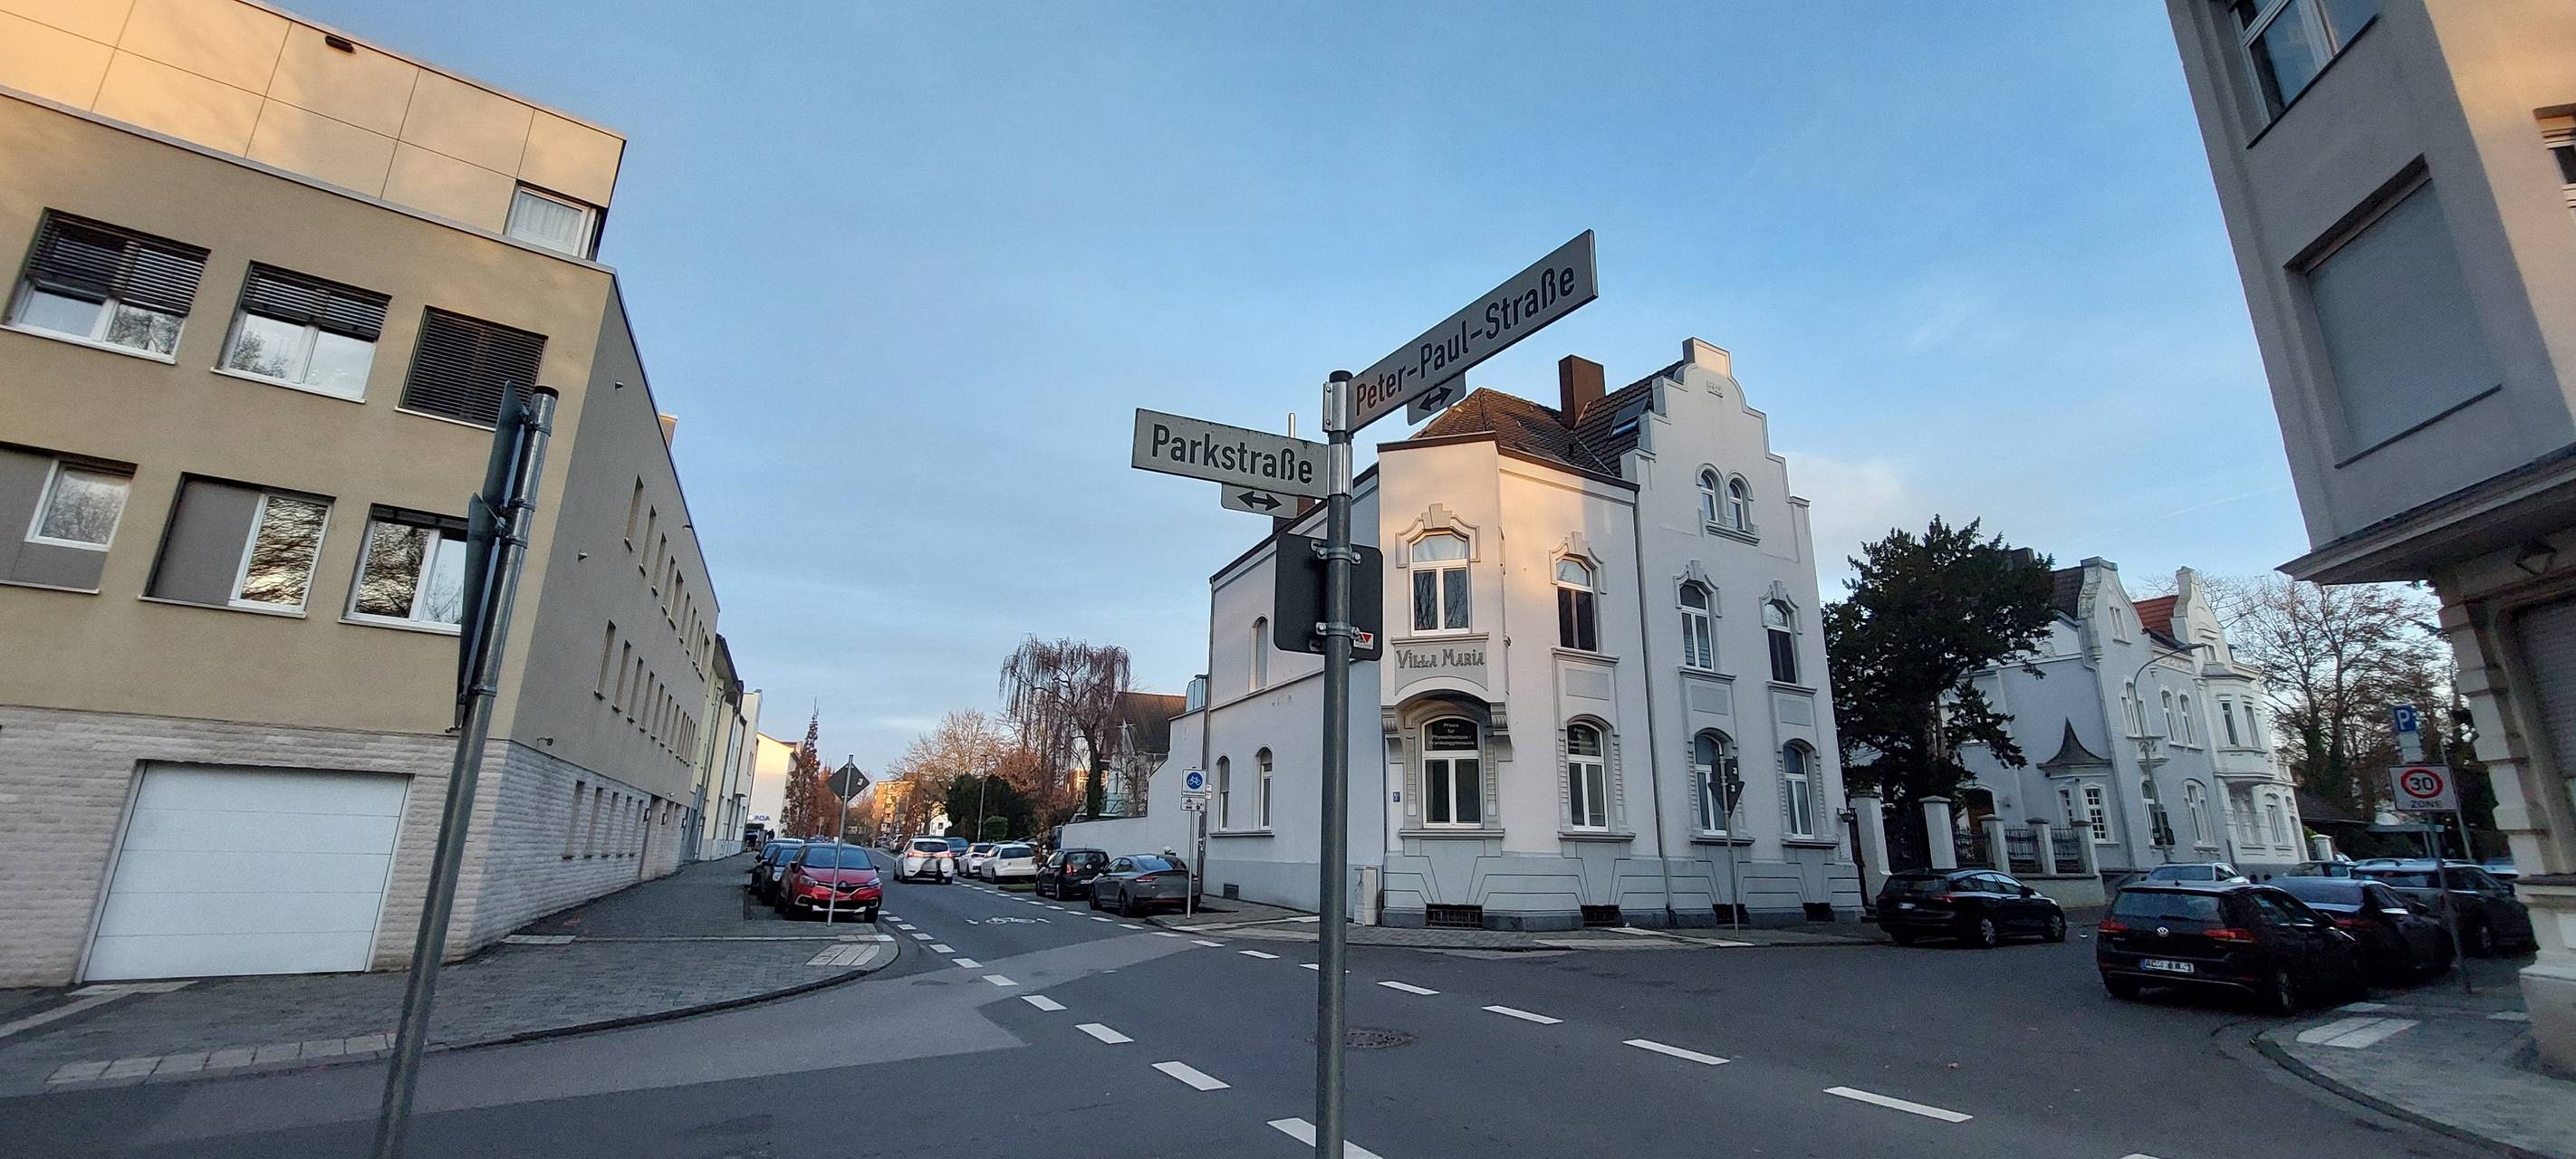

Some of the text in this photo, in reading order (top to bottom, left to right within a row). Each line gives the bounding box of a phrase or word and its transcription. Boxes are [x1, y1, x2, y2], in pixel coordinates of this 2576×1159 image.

[1356, 267, 1575, 417] Peter-Paul-Straße
[1151, 424, 1312, 484] Parkstraße
[2396, 709, 2410, 730] P
[2409, 777, 2435, 791] 30
[2410, 800, 2443, 809] ZONE
